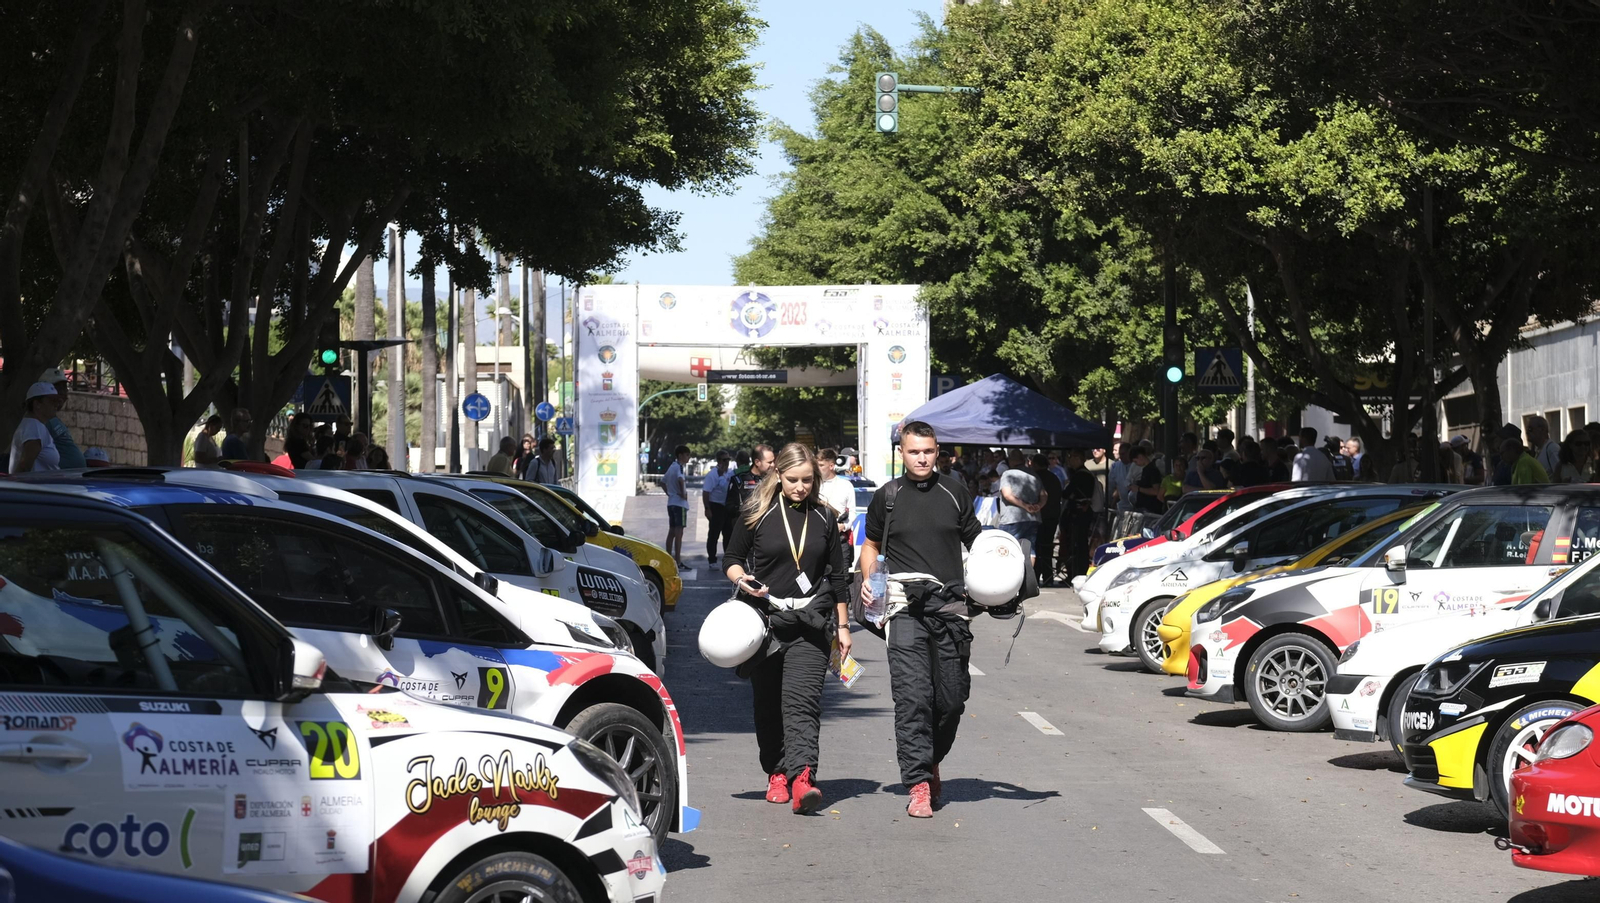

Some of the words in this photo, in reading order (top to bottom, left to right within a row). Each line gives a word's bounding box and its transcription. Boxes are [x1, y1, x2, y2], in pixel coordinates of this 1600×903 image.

[781, 302, 807, 326] 2023
[596, 328, 630, 336] ALMERÍA
[937, 377, 955, 396] P
[578, 572, 623, 593] LUMAI
[1373, 588, 1399, 614] 19
[400, 682, 426, 692] COSTA
[427, 683, 439, 692] DE
[486, 667, 504, 709] 9
[139, 701, 191, 712] SUZUKI
[1528, 709, 1573, 721] MICHELI
[168, 740, 216, 753] COSTA
[217, 741, 236, 753] DE
[300, 721, 360, 779] 20
[159, 754, 240, 776] ALMERÍA
[246, 759, 302, 767] CUPRA
[405, 755, 482, 816] Jade
[479, 749, 560, 803] Nails
[250, 800, 293, 809] DIPUTACIÓN
[320, 794, 363, 806] ALMERÍA
[261, 808, 292, 818] ALMERÍA
[468, 796, 521, 832] lounge
[63, 814, 170, 858] coto
[240, 843, 260, 851] UNED
[484, 861, 554, 882] MICHELIN
